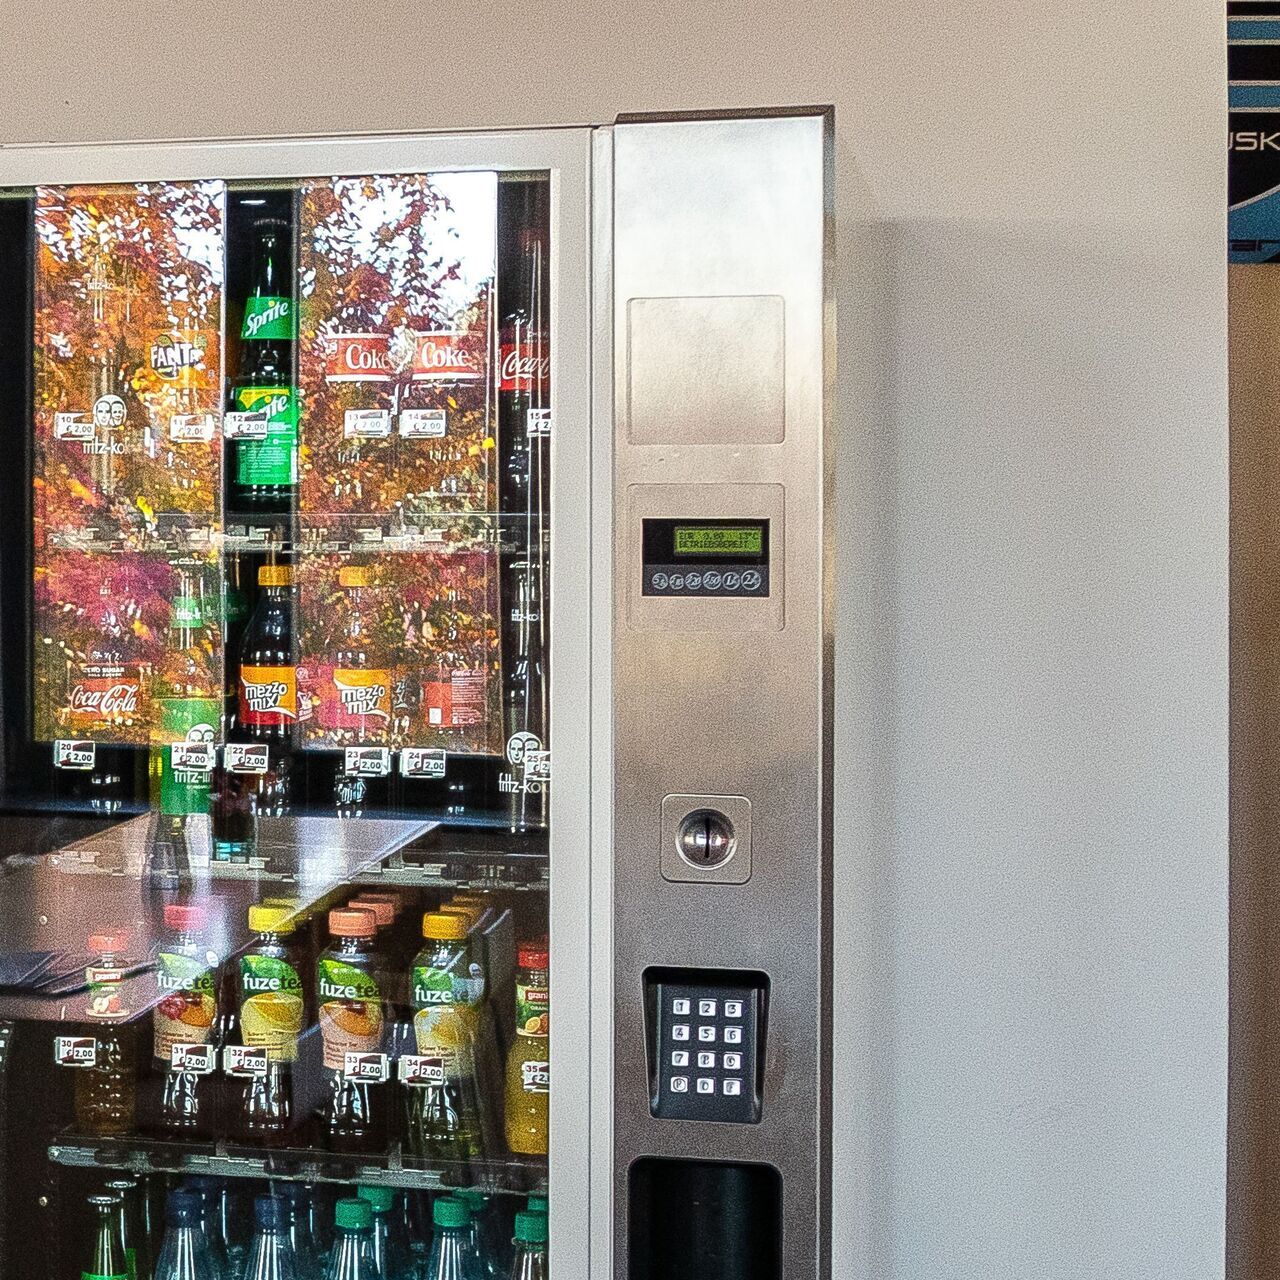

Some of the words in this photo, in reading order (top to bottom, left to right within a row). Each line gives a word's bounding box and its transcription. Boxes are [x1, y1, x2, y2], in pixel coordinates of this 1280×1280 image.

[244, 301, 290, 337] Sprite
[421, 341, 470, 369] Coke
[69, 684, 139, 714] Coca-Cola
[245, 681, 288, 700] mezzo
[342, 684, 385, 702] mezzo
[250, 696, 281, 712] mix
[346, 699, 379, 715] mix
